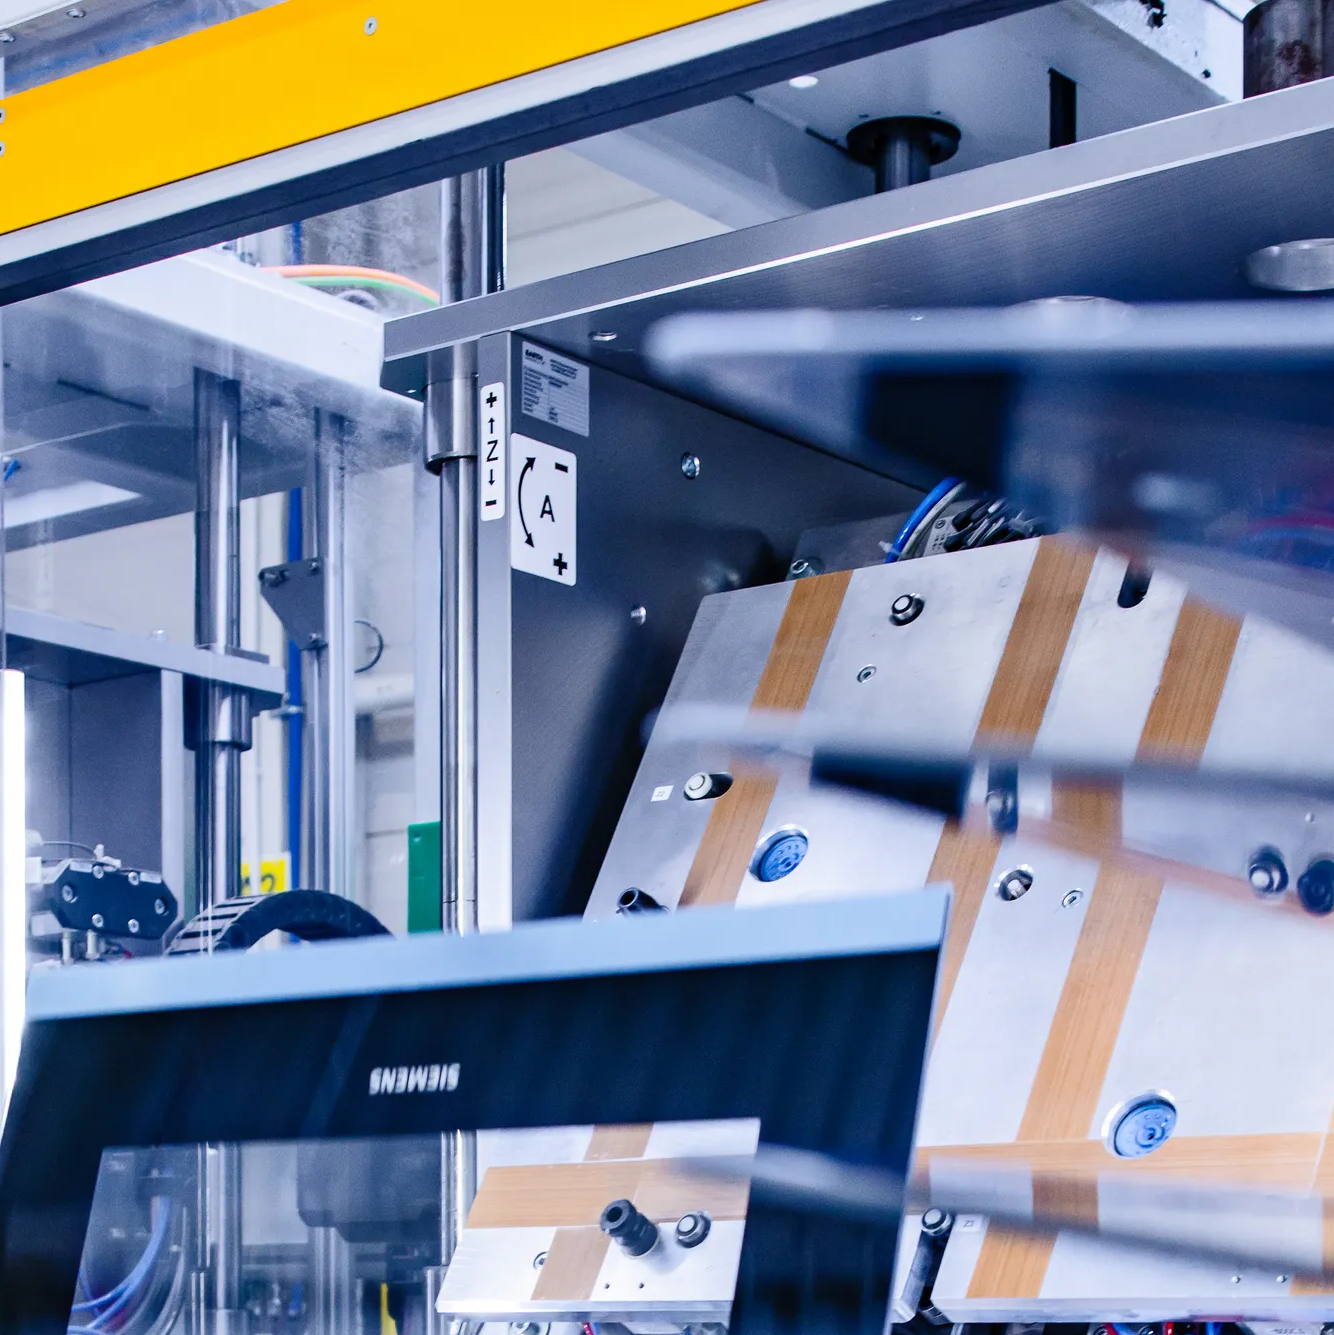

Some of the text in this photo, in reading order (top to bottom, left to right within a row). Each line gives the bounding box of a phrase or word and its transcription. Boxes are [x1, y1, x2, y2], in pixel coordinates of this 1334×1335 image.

[486, 440, 499, 462] Z
[540, 495, 555, 522] A
[369, 1062, 460, 1095] SIEMENS
